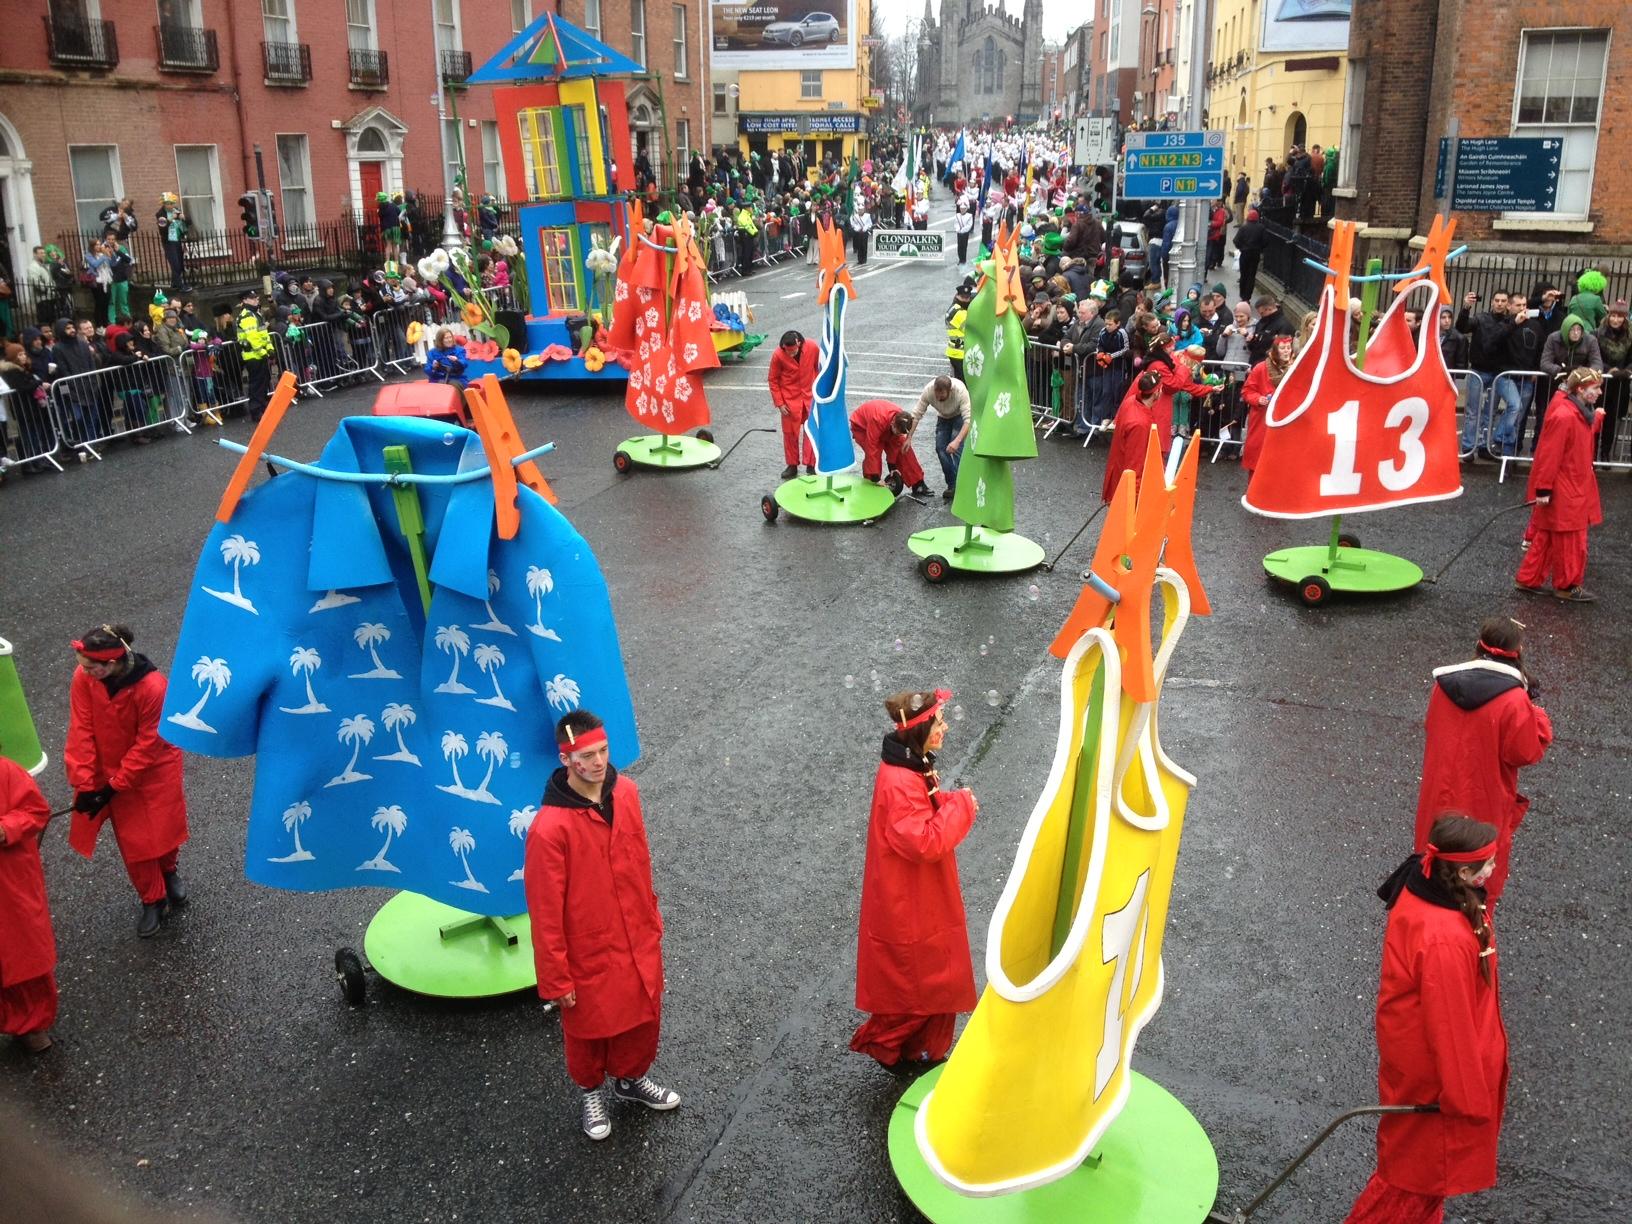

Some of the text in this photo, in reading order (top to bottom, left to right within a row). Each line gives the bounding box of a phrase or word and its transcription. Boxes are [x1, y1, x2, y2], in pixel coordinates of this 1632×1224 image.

[1163, 134, 1186, 146] J35
[1162, 180, 1171, 190] P
[880, 235, 939, 244] CLONDALKIN
[1319, 396, 1430, 497] 13
